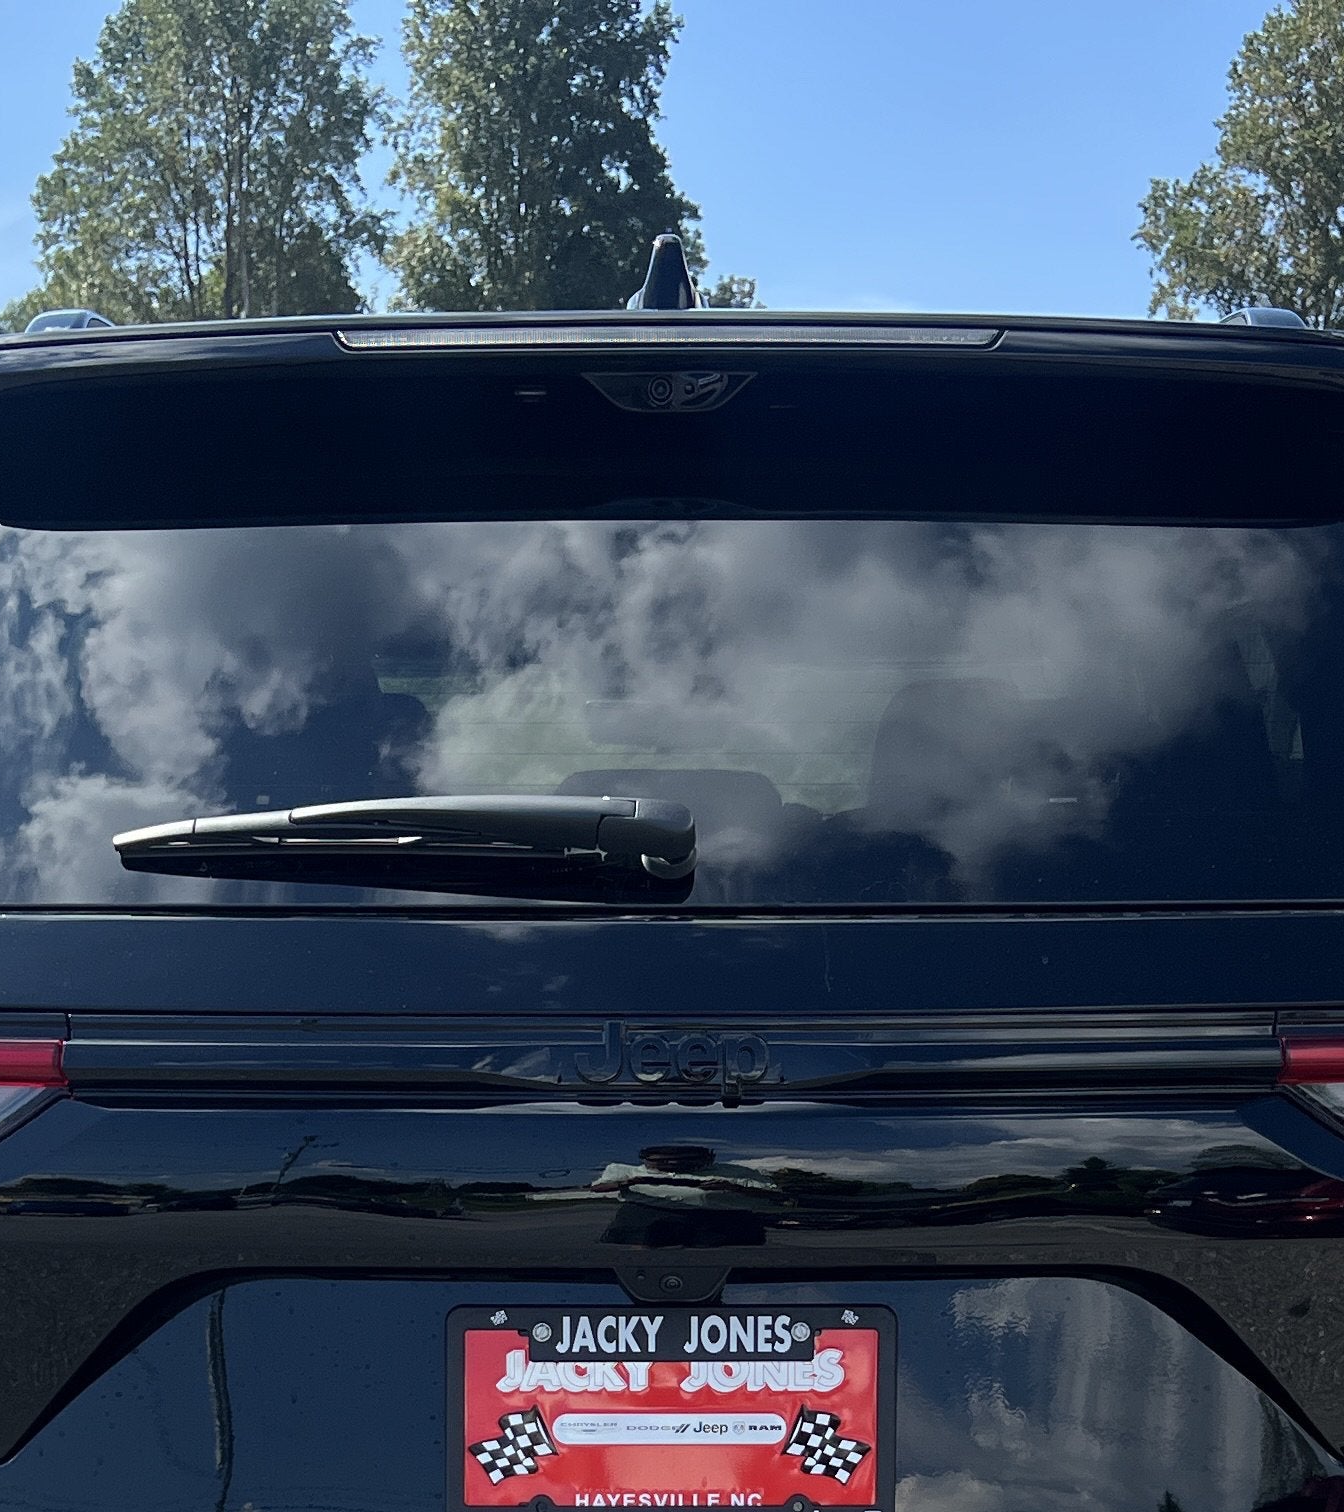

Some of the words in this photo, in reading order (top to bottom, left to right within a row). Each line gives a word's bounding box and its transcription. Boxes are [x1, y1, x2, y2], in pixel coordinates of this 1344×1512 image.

[574, 1020, 769, 1099] Jeep
[555, 1314, 664, 1354] JACKY
[683, 1314, 793, 1354] JONES
[496, 1349, 655, 1392] JACKY
[679, 1349, 845, 1392] JONES
[693, 1421, 729, 1435] Jeep
